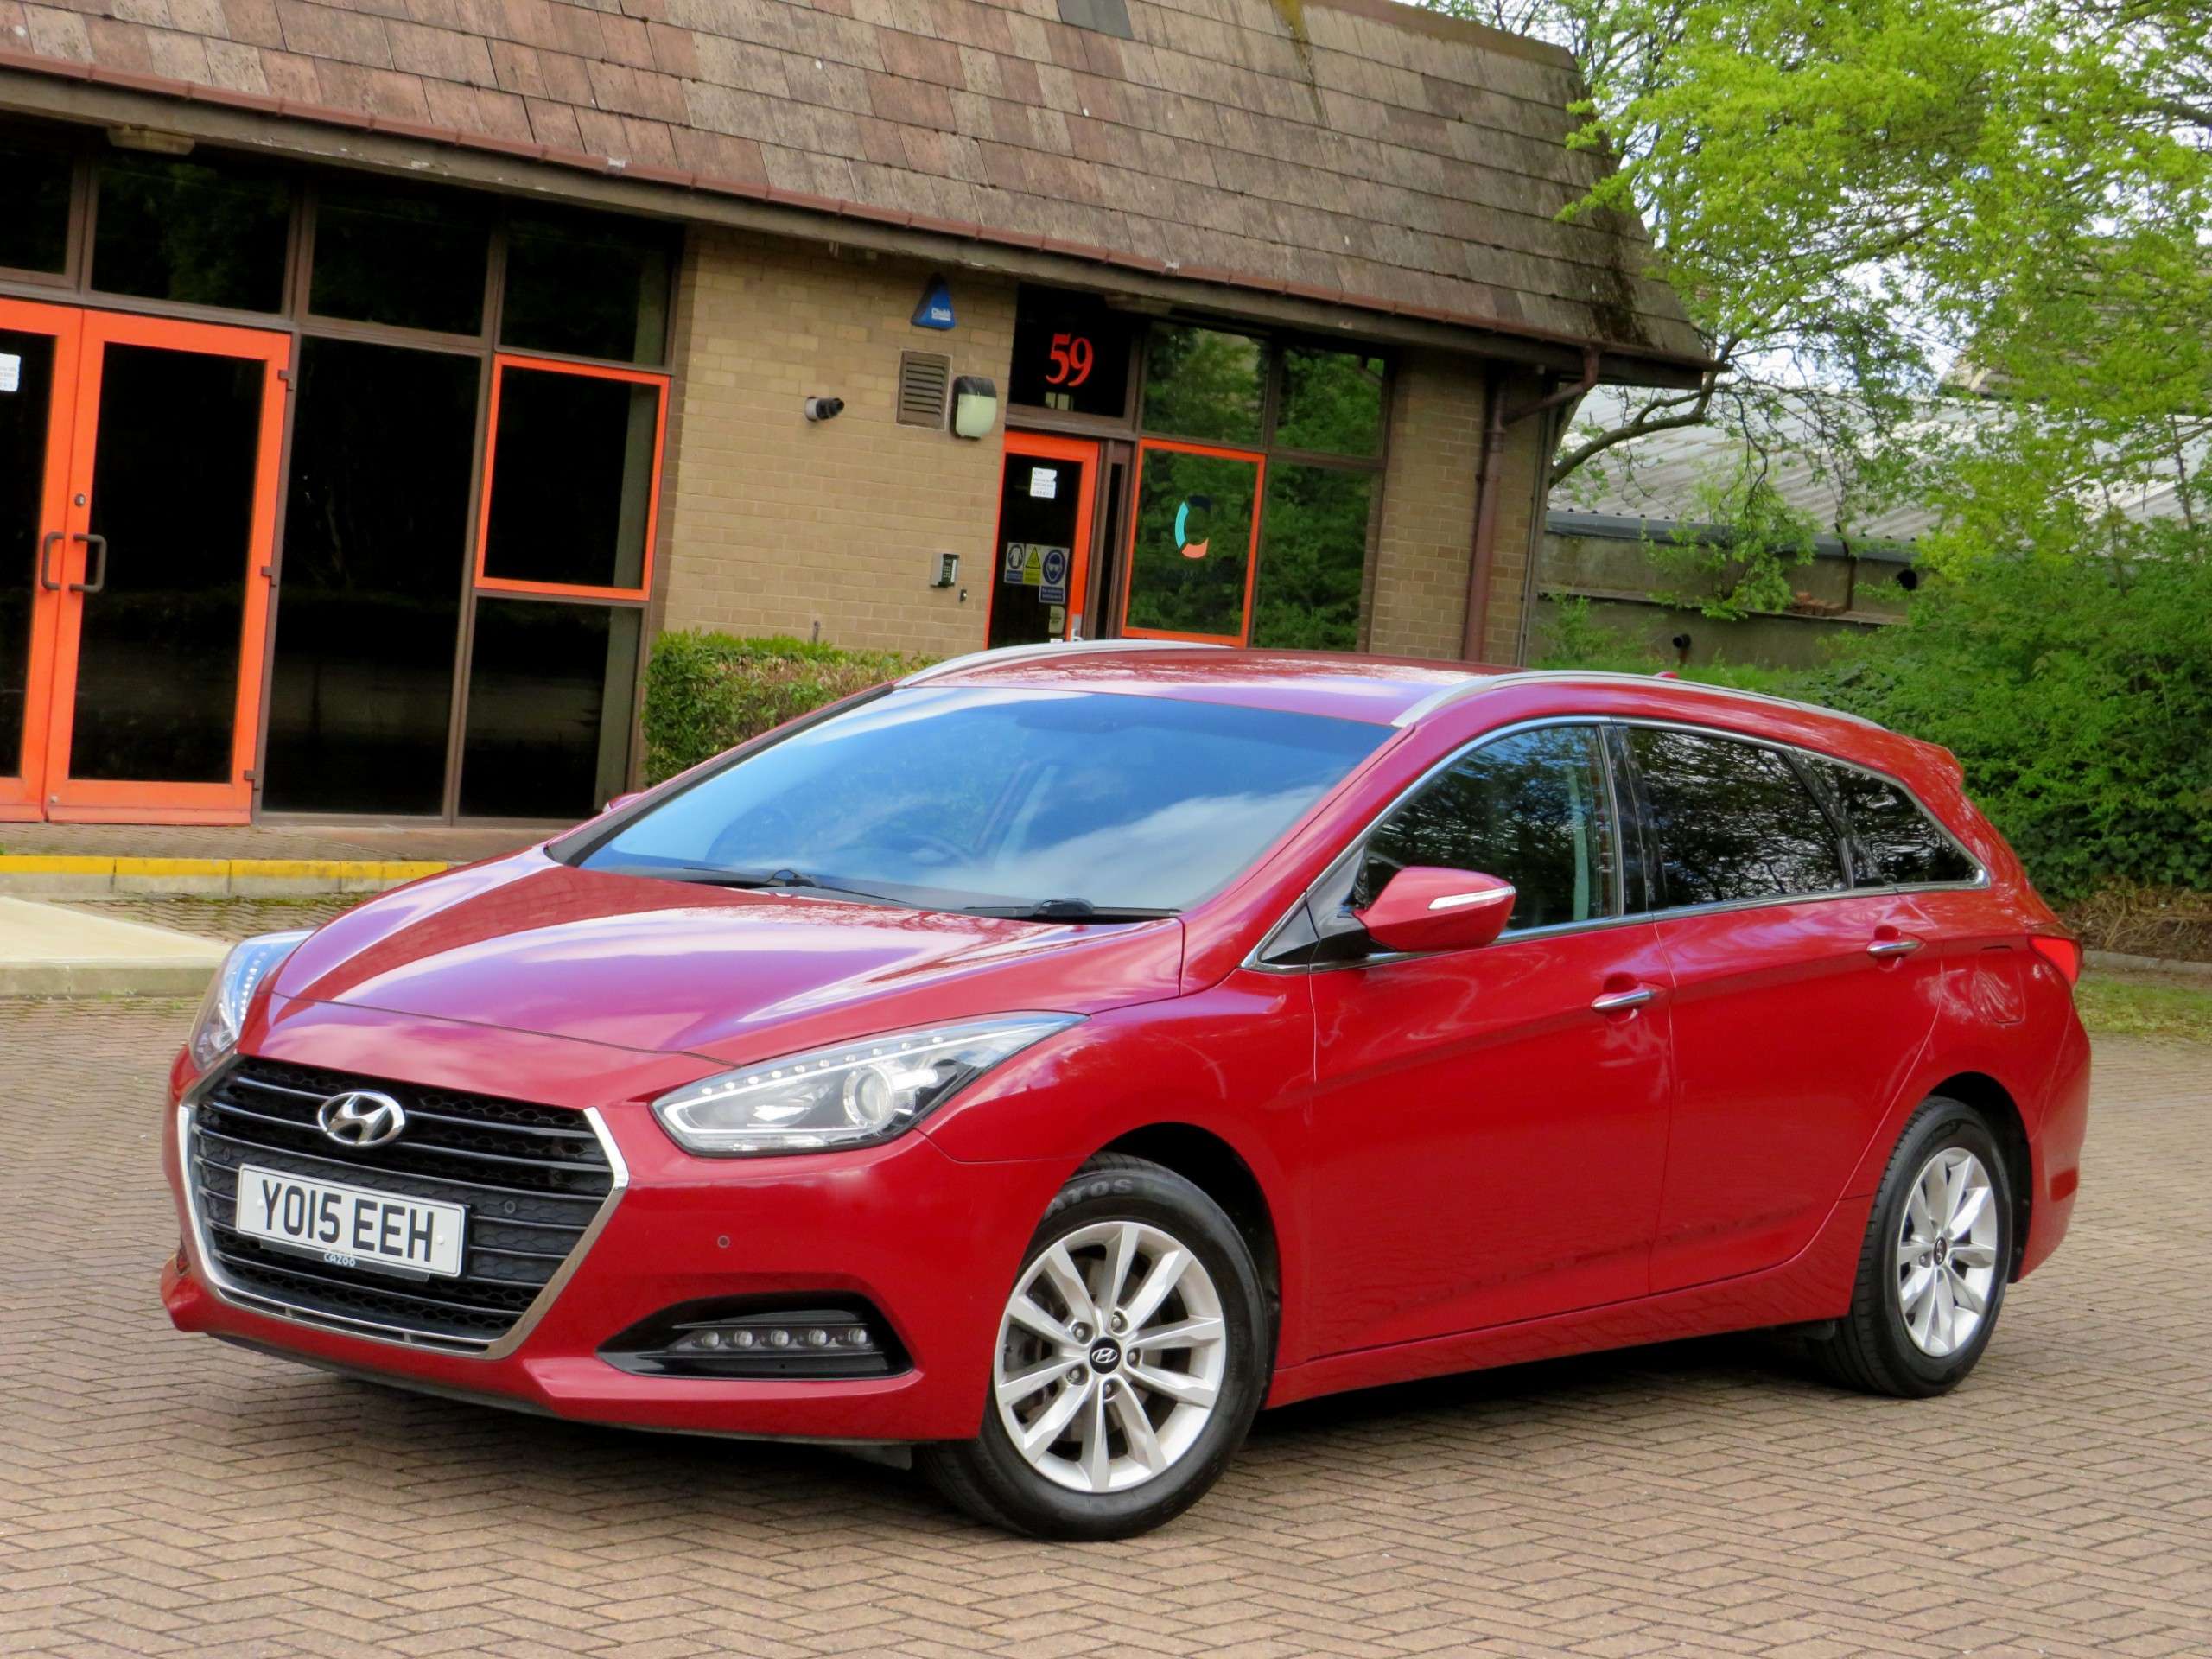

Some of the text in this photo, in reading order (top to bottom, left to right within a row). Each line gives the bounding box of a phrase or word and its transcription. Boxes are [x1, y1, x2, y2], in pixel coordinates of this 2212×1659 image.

[1046, 333, 1093, 387] 59
[262, 1179, 434, 1262] YO15 EEH
[324, 1253, 356, 1268] CAZOO
